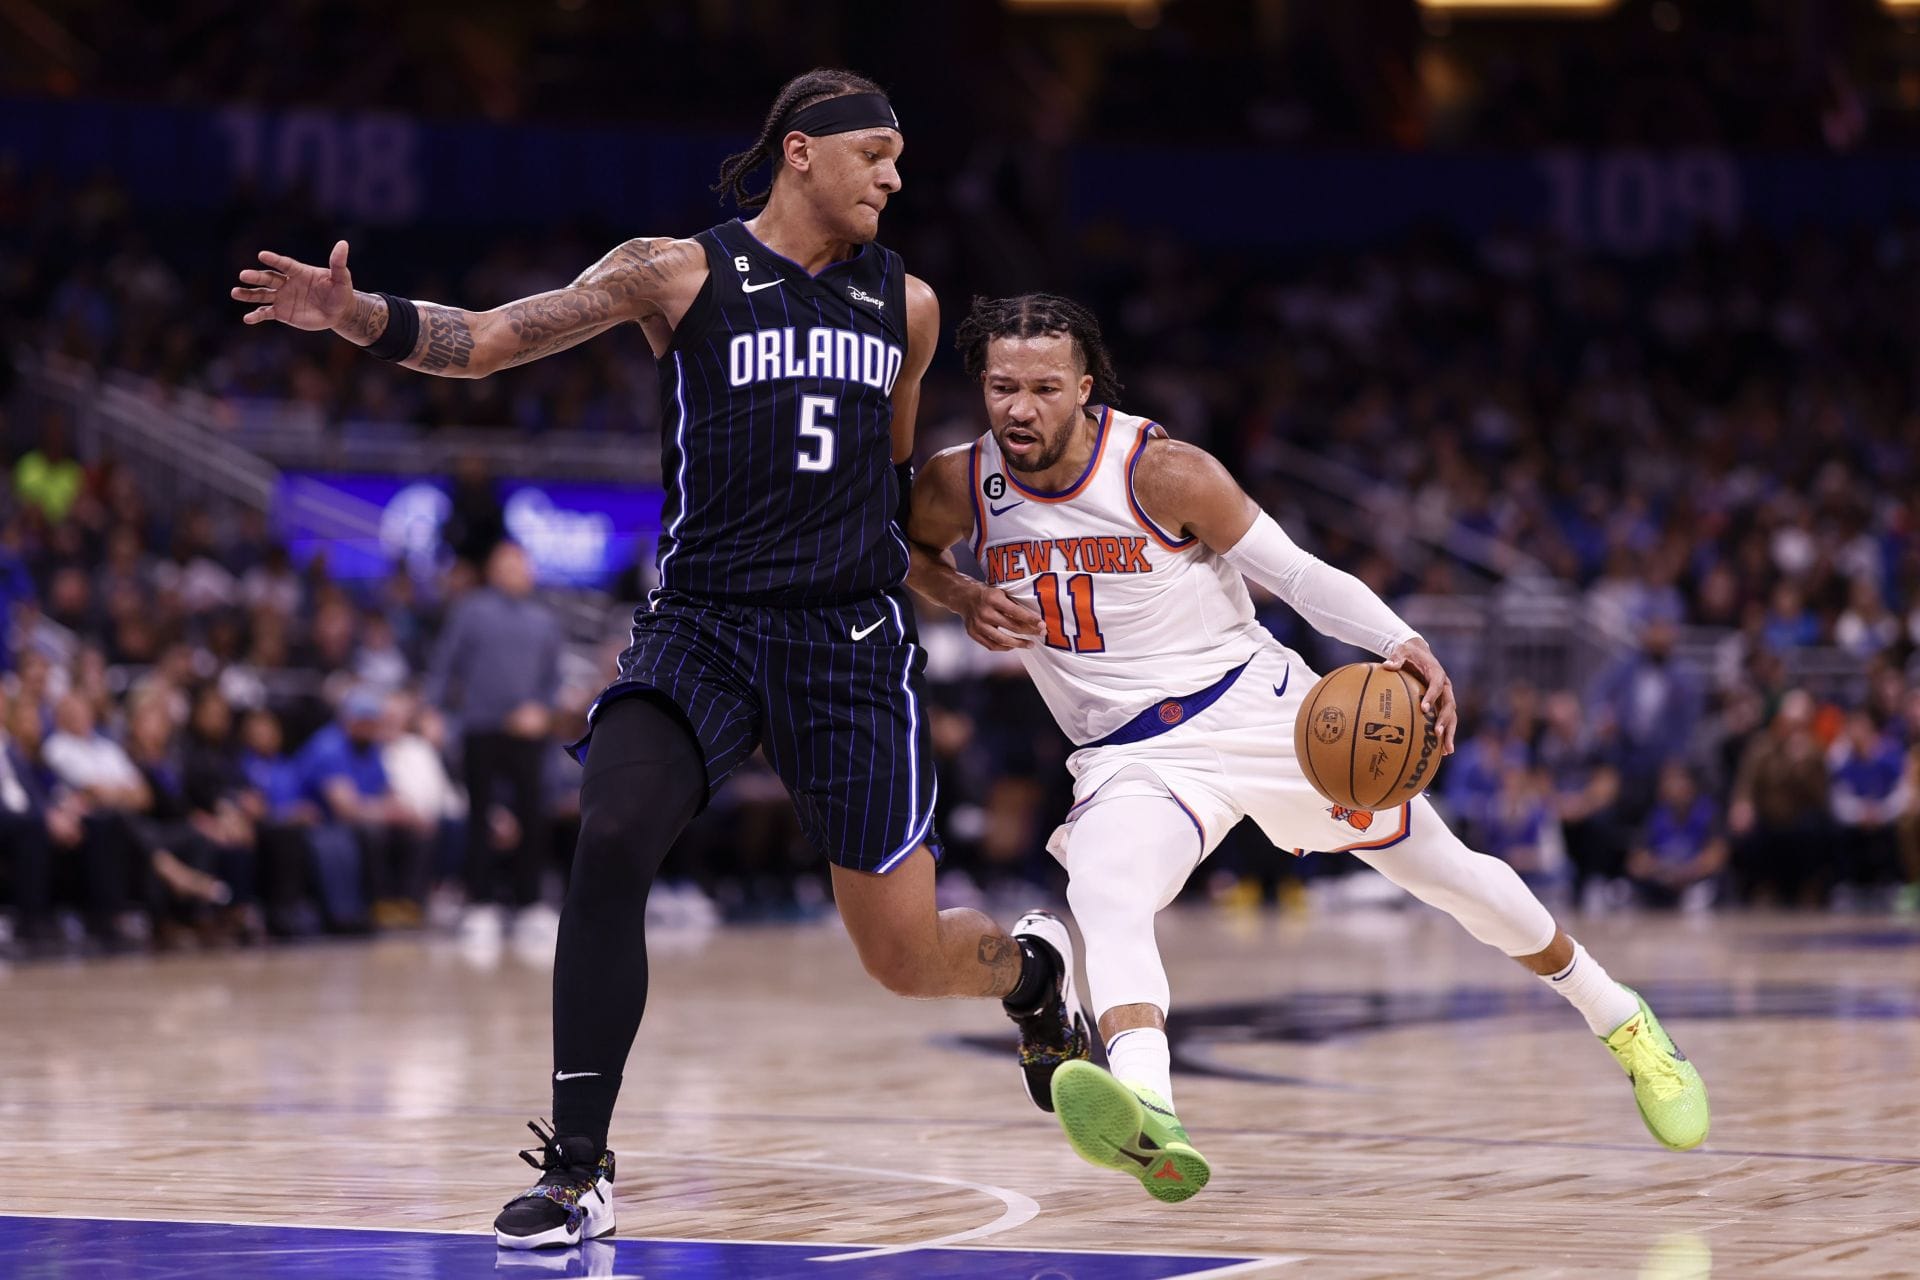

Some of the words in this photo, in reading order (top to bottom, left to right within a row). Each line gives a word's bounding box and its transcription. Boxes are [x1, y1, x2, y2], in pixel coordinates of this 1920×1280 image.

[213, 104, 419, 218] 108
[1537, 148, 1741, 250] 109
[733, 255, 750, 272] 6
[847, 285, 885, 310] Disney
[730, 326, 902, 397] ORLANDO
[797, 395, 837, 473] 5
[989, 477, 1003, 498] 6
[986, 540, 1053, 586] NEW
[1055, 536, 1152, 573] YORK
[1033, 572, 1106, 653] 11
